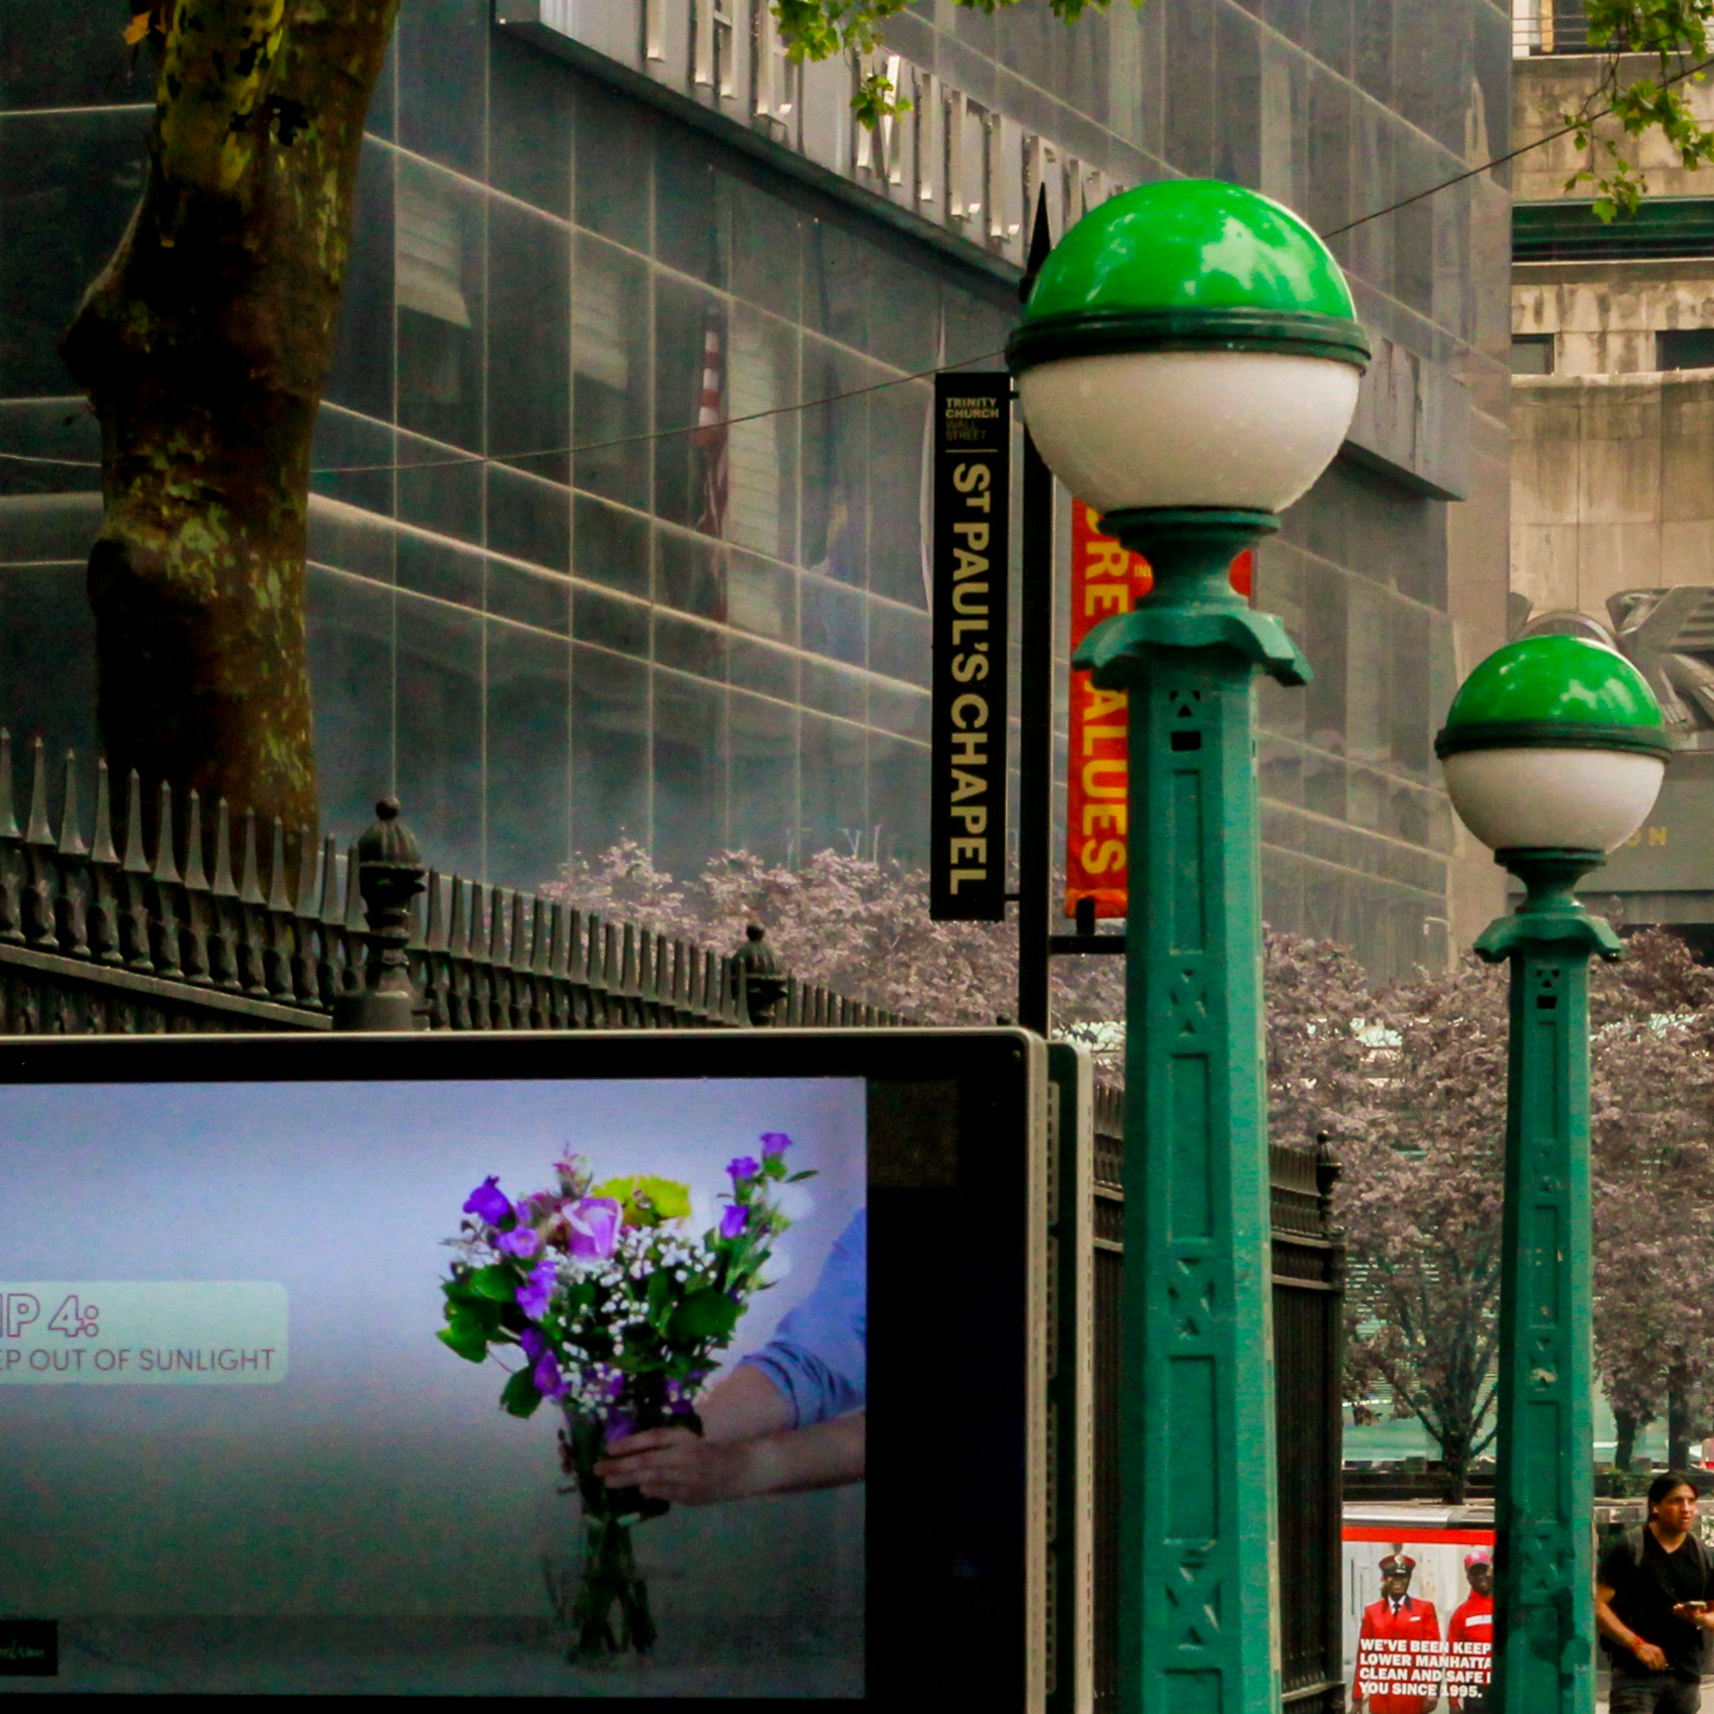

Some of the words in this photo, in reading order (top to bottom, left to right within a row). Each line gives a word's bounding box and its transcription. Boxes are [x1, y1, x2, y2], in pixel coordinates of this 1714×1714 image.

[946, 397, 997, 408] TRINITY
[945, 408, 999, 419] CHURCH
[1082, 682, 1129, 876] ALUES
[949, 695, 988, 896] CHAPEL
[48, 1294, 100, 1338] 4:
[29, 1349, 87, 1372] OUT
[94, 1349, 131, 1372] OF
[139, 1347, 276, 1371] SUNLIGHT
[1360, 1638, 1407, 1652] WE'VE
[1410, 1640, 1449, 1653] BEEN
[1453, 1642, 1492, 1655] KEEP
[1360, 1653, 1412, 1666] LOWER
[1416, 1655, 1492, 1669] MANHATTA
[1359, 1667, 1408, 1680] CLEAN
[1411, 1669, 1443, 1682] AND
[1446, 1671, 1483, 1683] SAFE
[1359, 1682, 1389, 1694] YOU
[1392, 1683, 1437, 1696] SINCE
[1440, 1684, 1483, 1698] 1995.
